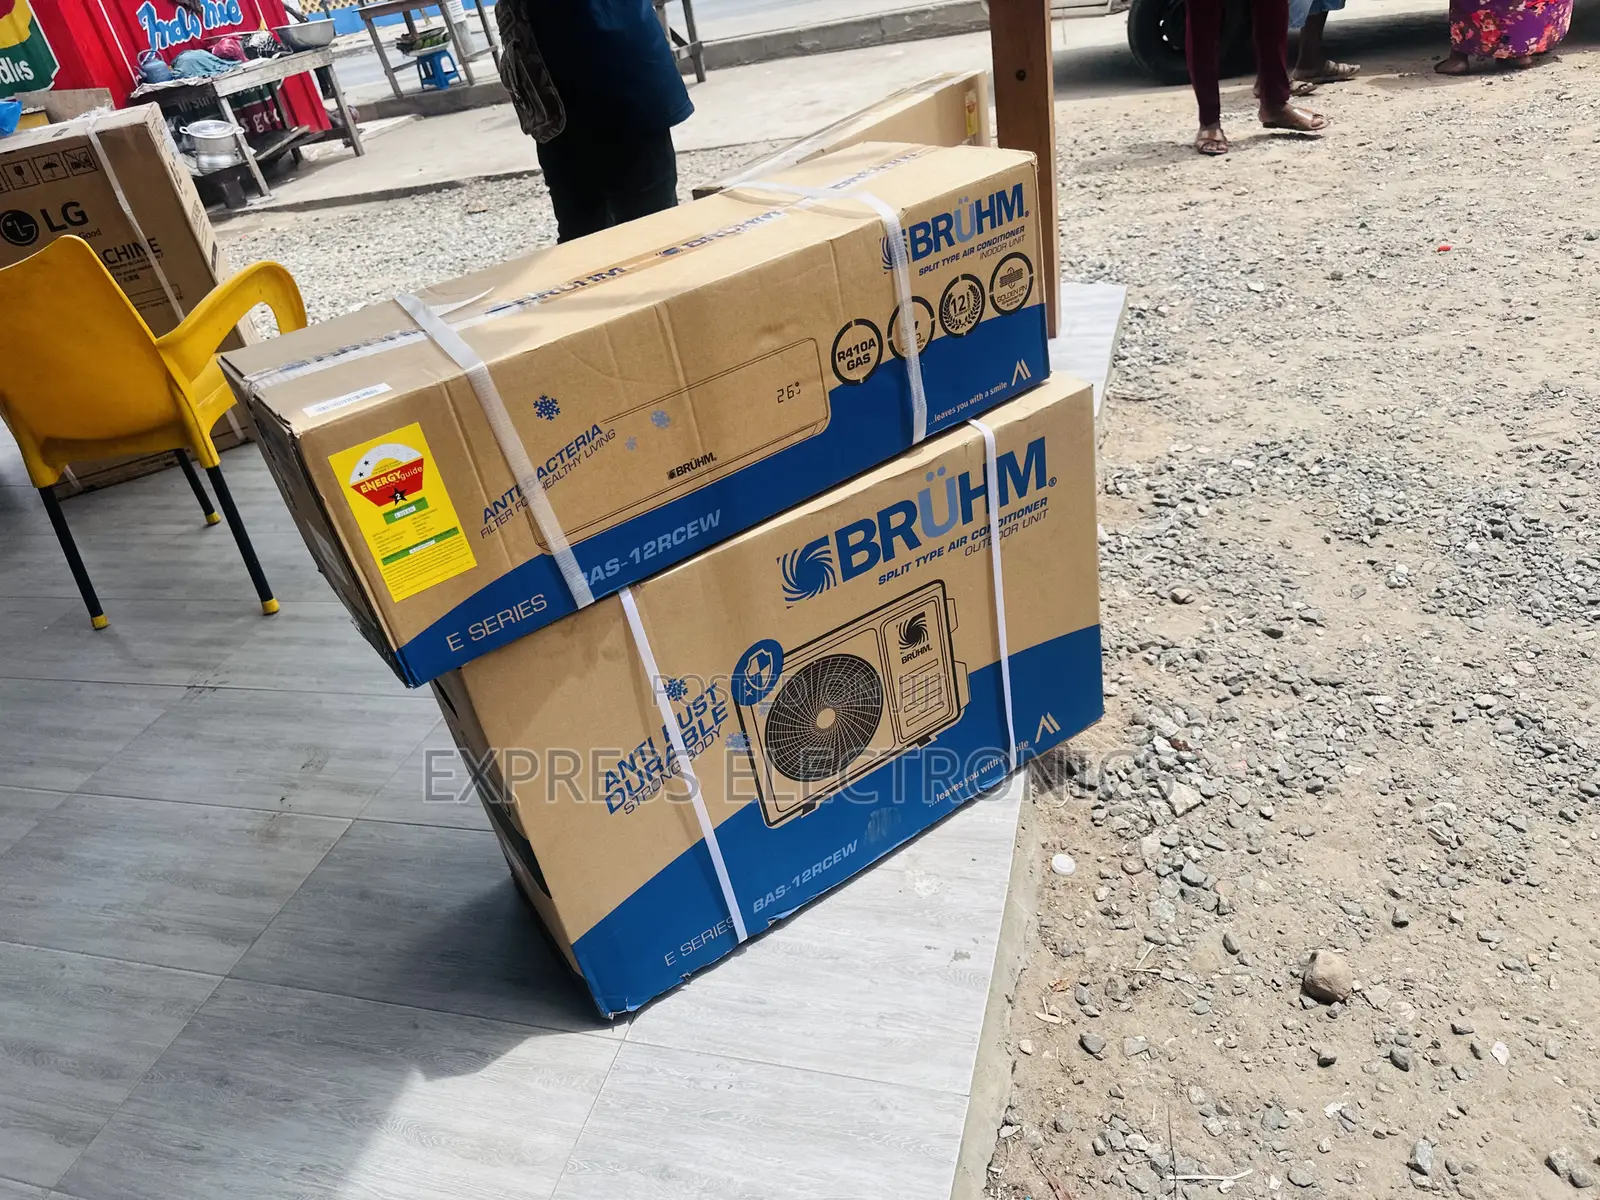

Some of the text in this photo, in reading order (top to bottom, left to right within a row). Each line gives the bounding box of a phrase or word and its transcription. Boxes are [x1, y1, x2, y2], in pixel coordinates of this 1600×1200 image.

[40, 201, 89, 233] LG
[102, 238, 162, 265] CHINE
[919, 225, 1025, 276] SPLIT TYPE AIR CONDITIONER
[980, 234, 1025, 260] INDOOR UNIT
[837, 338, 877, 363] R410A
[846, 353, 871, 371] GAS
[956, 402, 969, 413] you
[969, 392, 984, 405] with
[990, 381, 1008, 396] smile
[480, 508, 514, 539] FILTER
[584, 428, 616, 459] LIVING
[1022, 508, 1049, 531] UNIT
[878, 562, 911, 586] SPLIT
[915, 545, 944, 568] TYPE
[948, 535, 968, 553] AIR
[446, 593, 548, 652] E SERIES
[605, 700, 729, 815] DURABLE
[605, 736, 657, 793] ANTI
[623, 724, 722, 815] STRONG BODY
[964, 770, 980, 787] you
[980, 758, 1000, 775] with
[753, 839, 858, 914] BAS-12RCEW
[664, 916, 735, 966] E SERIES
